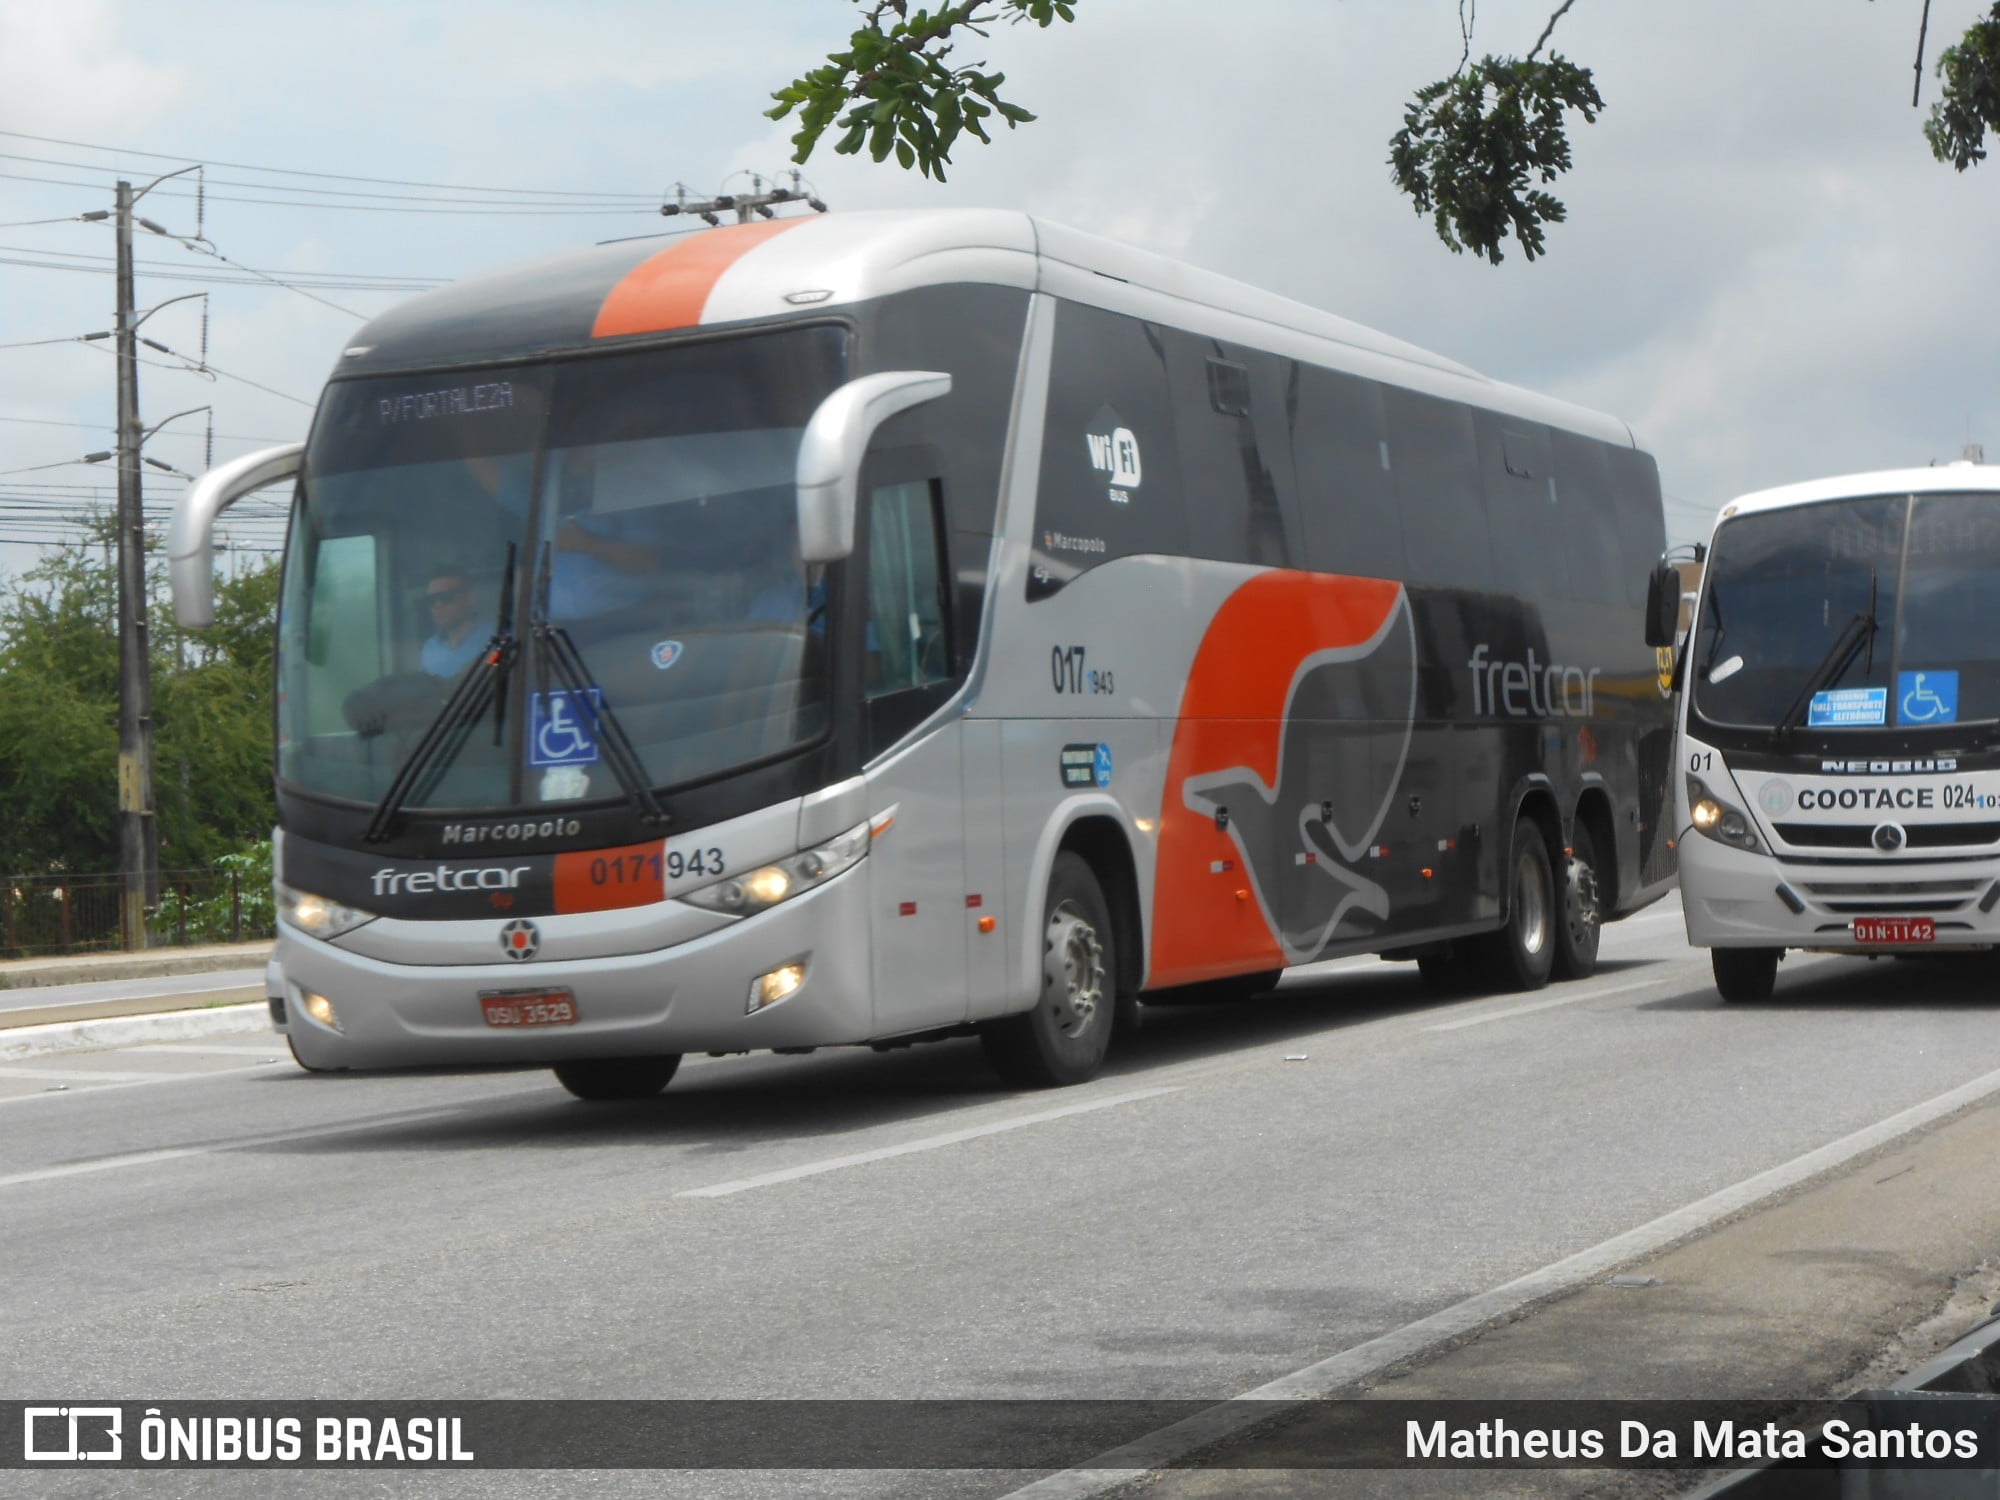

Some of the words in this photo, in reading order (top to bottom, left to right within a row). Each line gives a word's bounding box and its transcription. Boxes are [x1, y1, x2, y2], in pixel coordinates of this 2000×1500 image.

[1053, 532, 1106, 553] Marcopolo
[1468, 643, 1601, 717] fretcar
[1690, 752, 1712, 772] 01
[1822, 758, 1957, 773] NEOBUS
[1798, 788, 1933, 810] COOTACE
[442, 817, 581, 845] Marcopolo
[370, 865, 531, 896] fretcar
